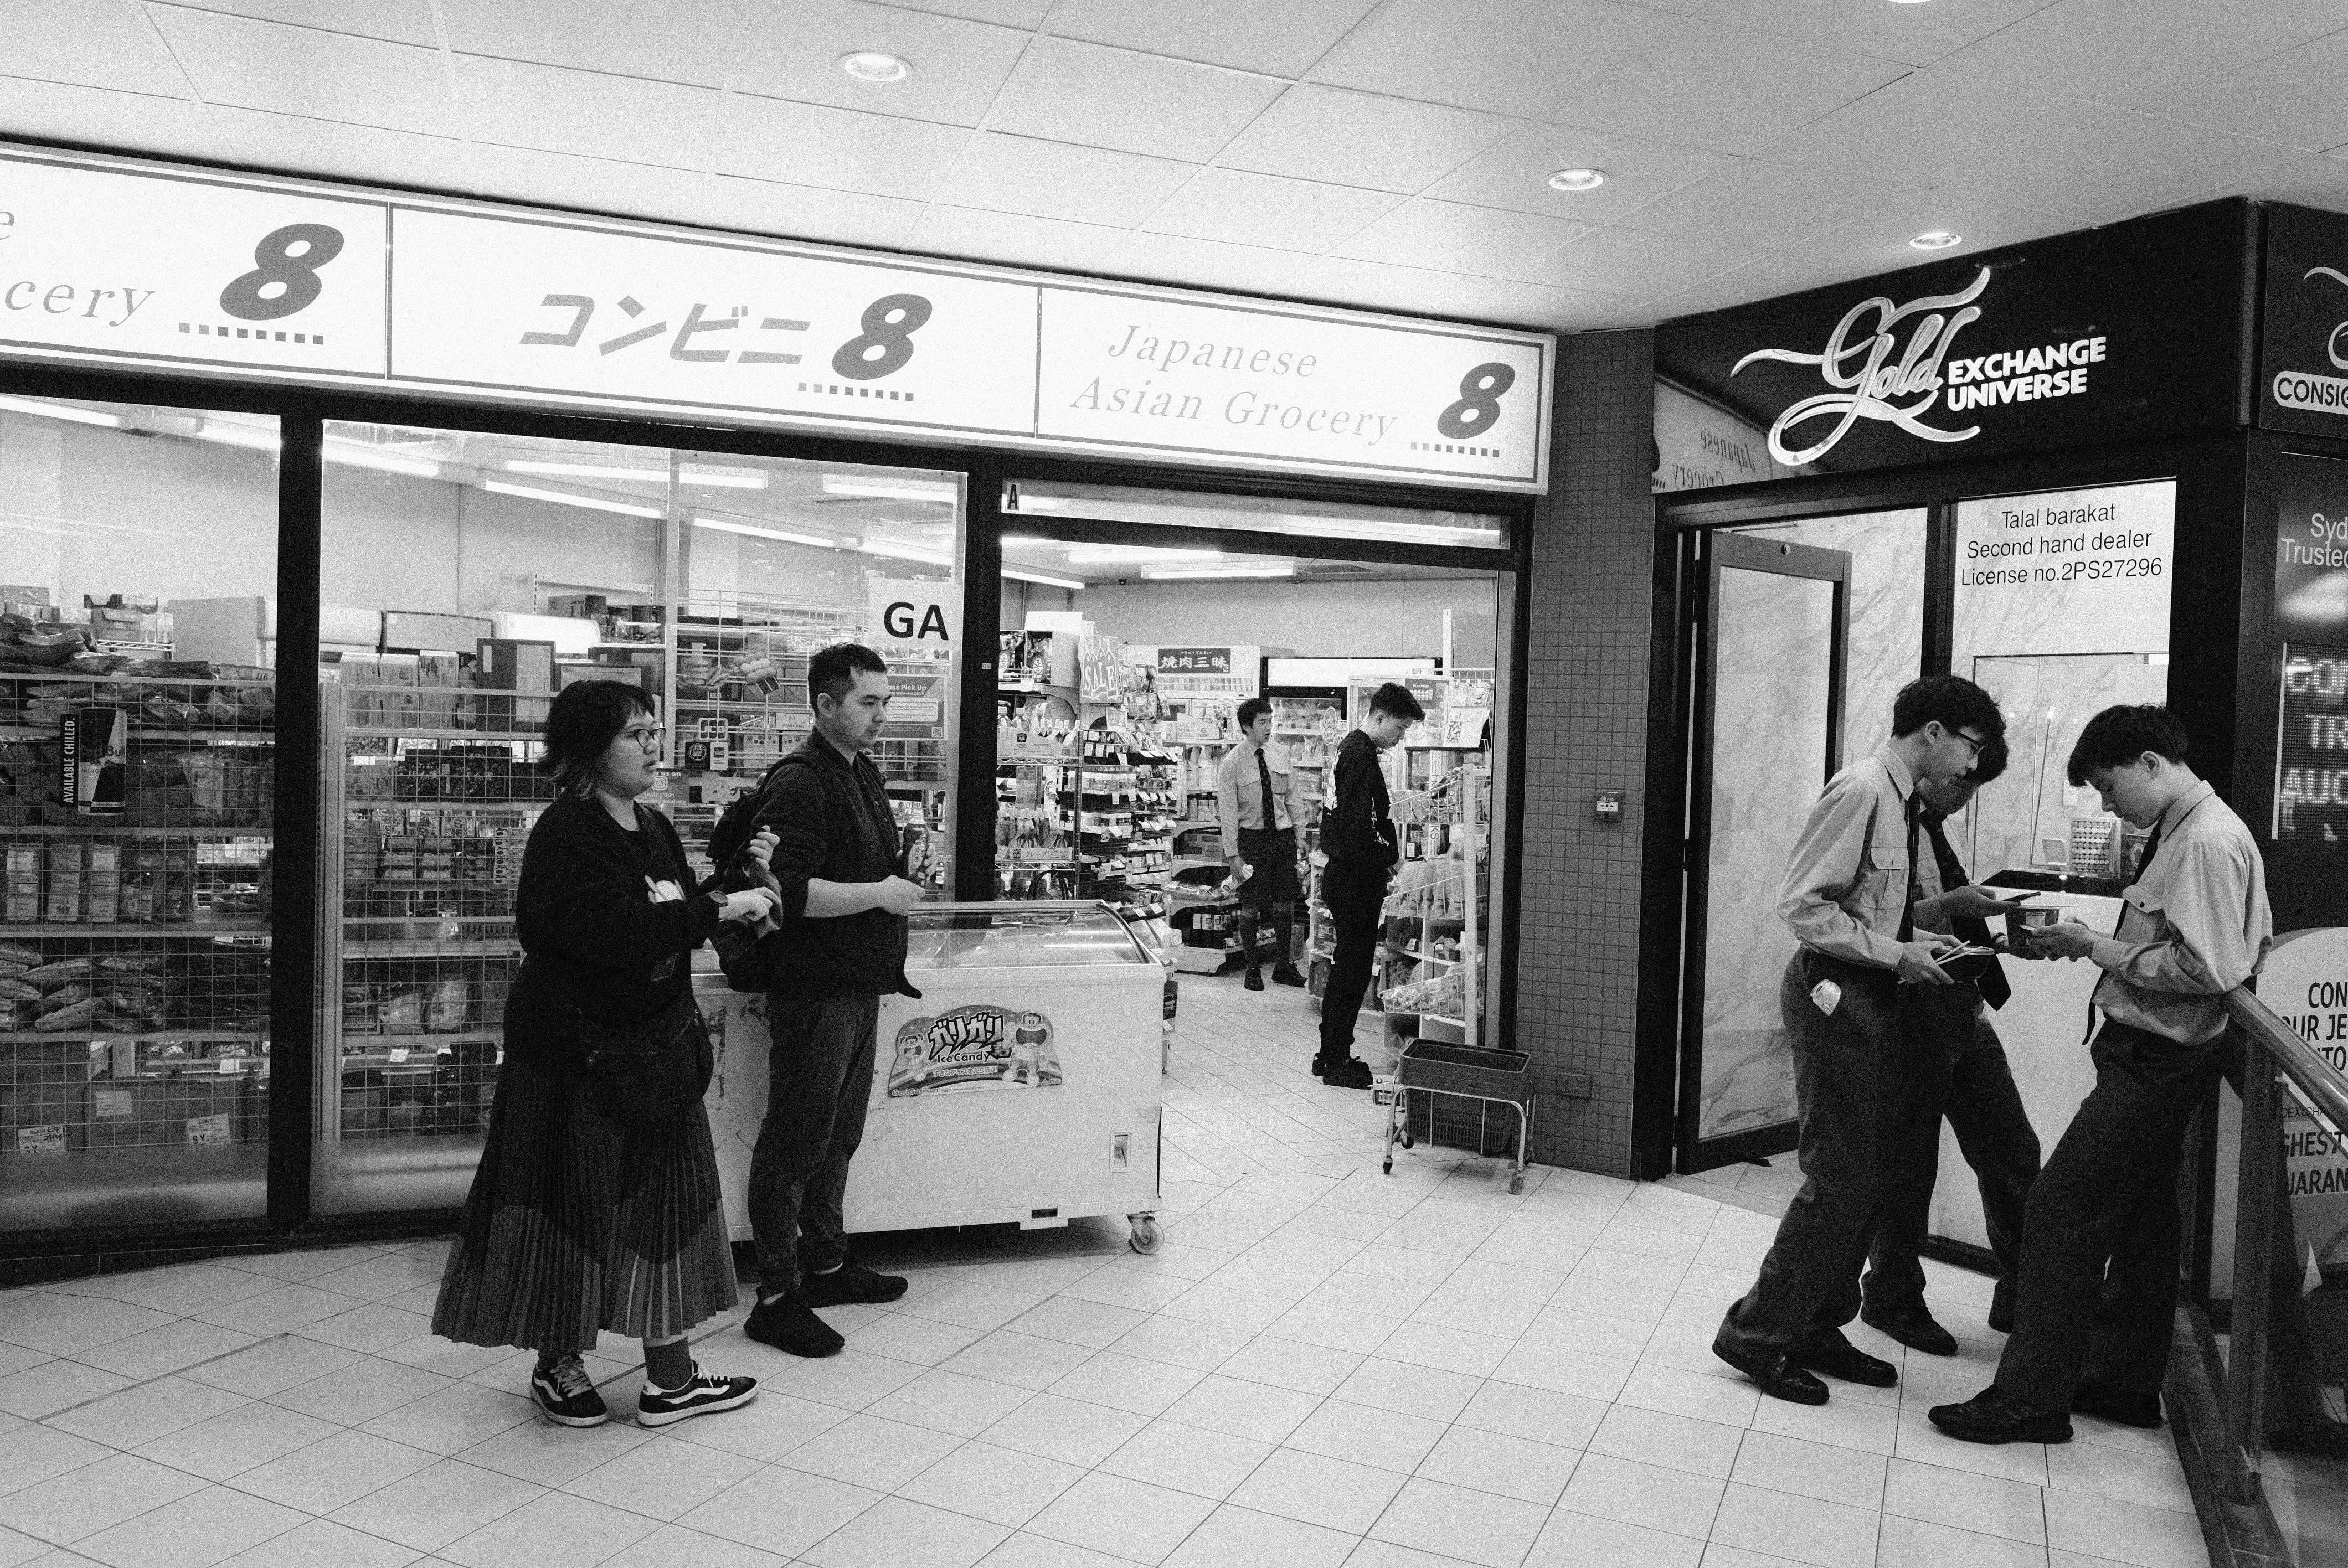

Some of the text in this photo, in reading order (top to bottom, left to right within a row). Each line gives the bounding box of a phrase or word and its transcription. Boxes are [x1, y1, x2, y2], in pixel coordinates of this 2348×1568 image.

[219, 223, 344, 321] 8
[519, 293, 933, 380] コンビニ 8
[1108, 324, 1318, 378] Japanese
[1729, 267, 1992, 466] Gold
[1948, 336, 2107, 384] EXCHANGE
[1069, 376, 1398, 446] Asian Grocery
[1436, 362, 1515, 440] 8
[1947, 368, 2087, 411] UNIVERSE
[1007, 484, 1018, 509] A
[2001, 503, 2115, 530] Talal barakat
[1966, 530, 2152, 560] Second hand dealer
[1961, 558, 2162, 587] License no.2PS27296
[884, 602, 949, 641] GA
[1084, 662, 1115, 692] SALE
[1158, 655, 1229, 669] 焼肉三昧
[63, 718, 76, 803] AVAILABLE CHILLED.
